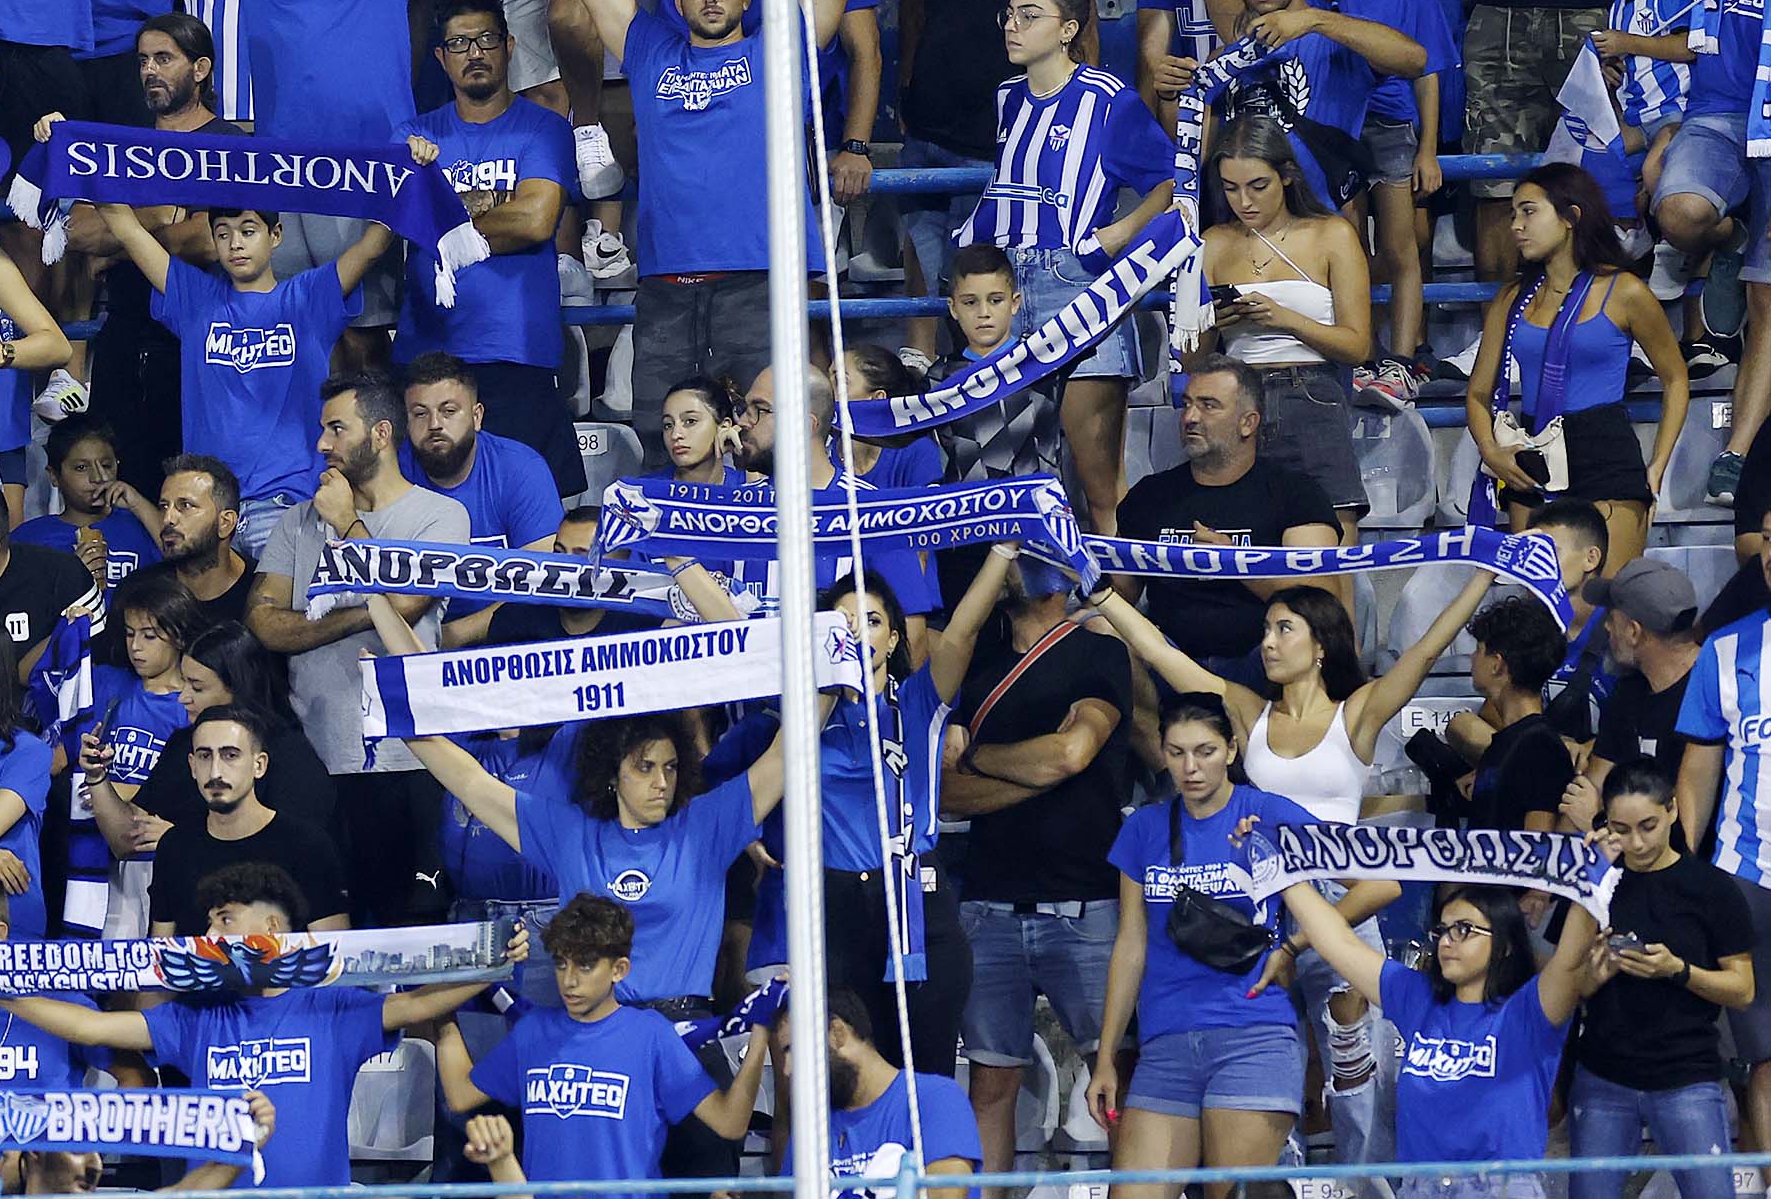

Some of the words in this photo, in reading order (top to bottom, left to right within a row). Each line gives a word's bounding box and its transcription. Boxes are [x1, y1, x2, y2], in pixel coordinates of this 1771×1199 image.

[67, 140, 415, 199] ANORTHOSIS
[577, 434, 600, 450] 98
[668, 483, 710, 501] 1911
[731, 488, 776, 504] 2011
[907, 532, 941, 548] 100
[950, 521, 1023, 543] ΧΡΟΝΙΑ
[312, 545, 638, 602] ΑΝΟΡΘΩΣΙΣ
[441, 643, 577, 688] ΑΝΟΡΘΩΣΙΣ
[580, 626, 749, 673] ΑΜΜΟΧΩΣΤΟΥ
[572, 681, 625, 712] 1911
[112, 941, 151, 969] TO
[208, 1050, 308, 1081] MAXHTEC
[43, 1091, 253, 1152] BROTHERS
